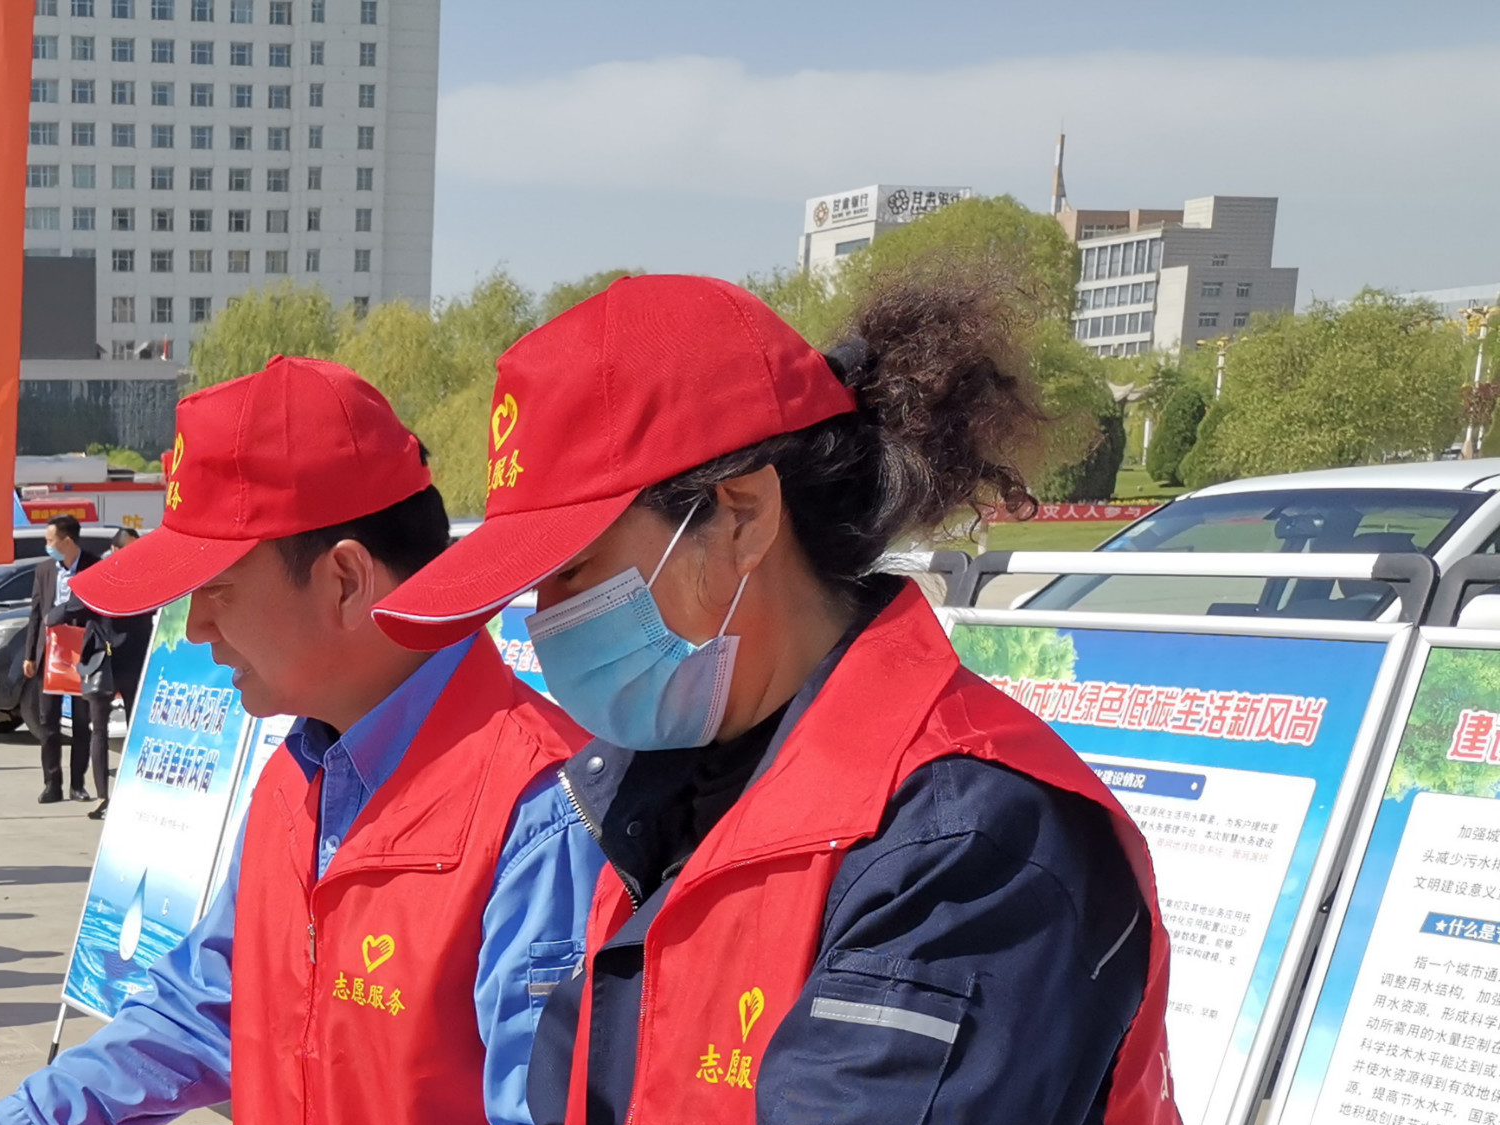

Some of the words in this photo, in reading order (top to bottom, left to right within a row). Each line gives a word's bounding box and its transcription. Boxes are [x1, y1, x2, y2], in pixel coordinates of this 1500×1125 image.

[1450, 712, 1500, 760] 建
[1413, 876, 1500, 900] 文明建设意义
[1414, 955, 1500, 982] 指一个城市通
[332, 971, 405, 1016] 志愿服务
[695, 1044, 757, 1089] 志愿服
